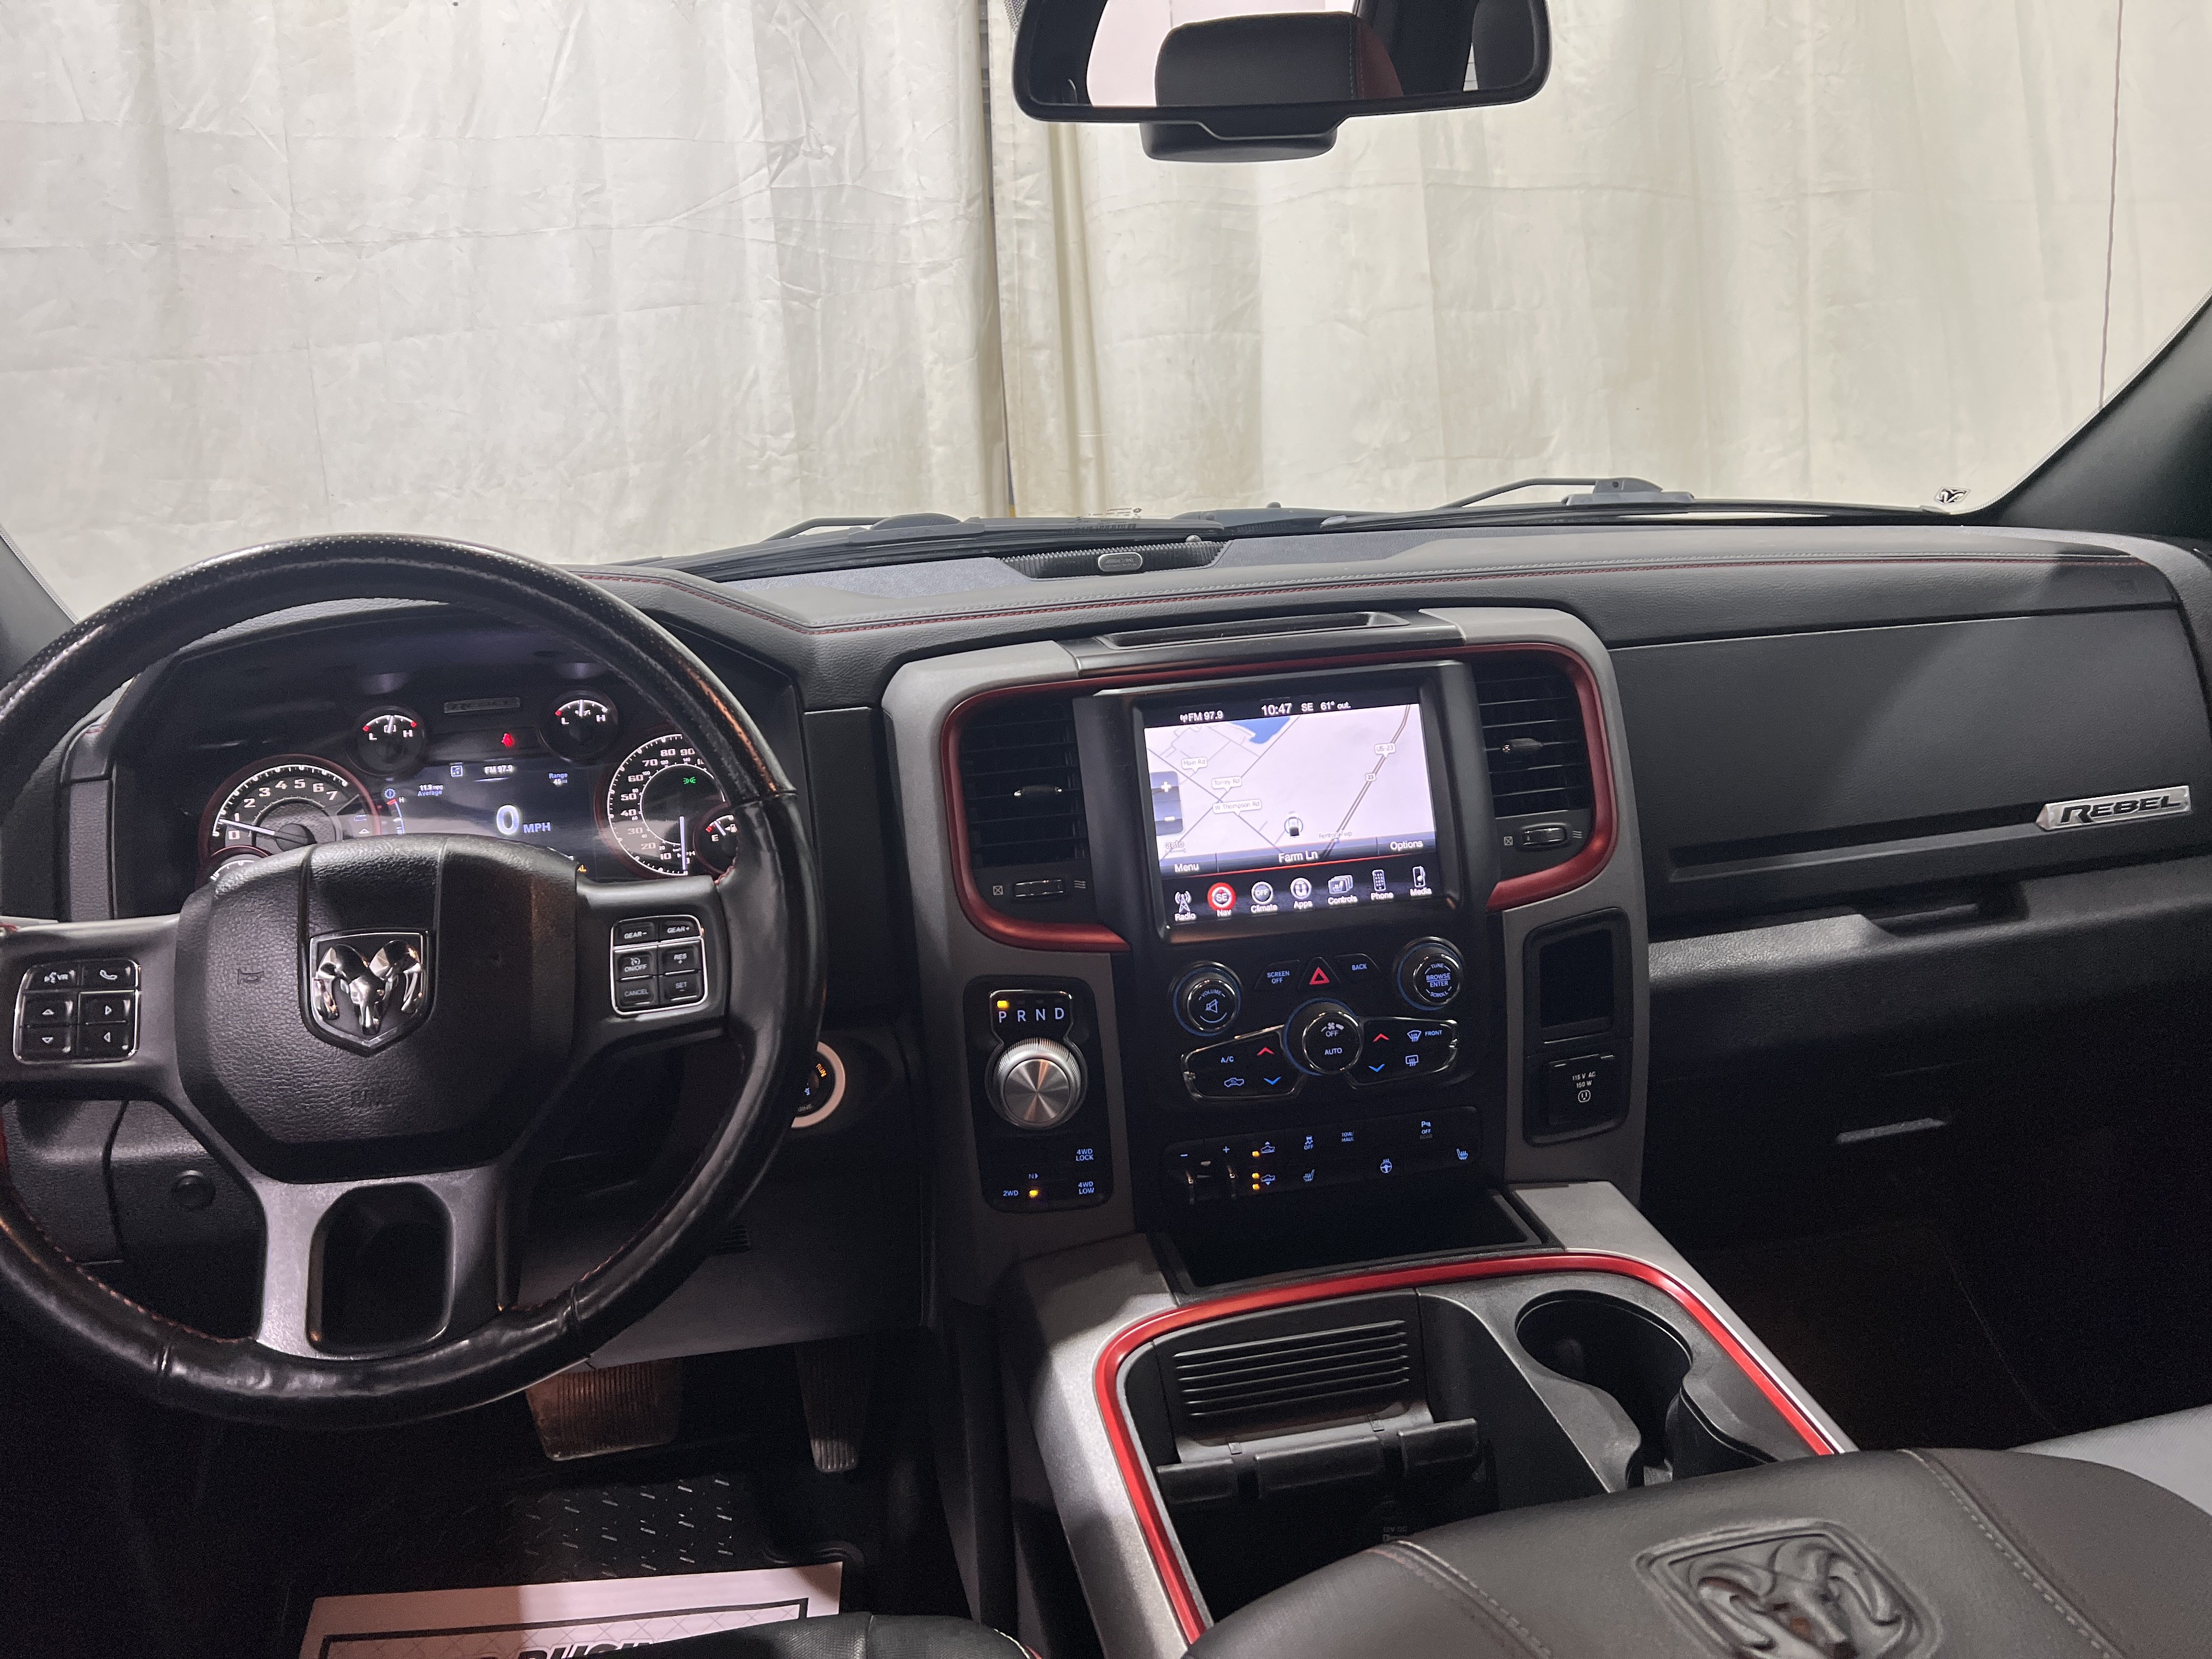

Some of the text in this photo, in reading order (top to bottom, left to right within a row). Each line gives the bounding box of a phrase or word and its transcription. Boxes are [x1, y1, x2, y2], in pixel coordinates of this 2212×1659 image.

[1261, 703, 1292, 716] 10:47
[1301, 703, 1314, 712] SE
[1320, 701, 1351, 711] 61° out.
[1188, 710, 1223, 722] FM 97.9
[369, 732, 377, 741] L
[660, 748, 676, 757] 80
[484, 766, 496, 774] FM
[628, 774, 644, 782] 60
[275, 780, 287, 789] 4
[295, 779, 306, 788] 5
[313, 783, 324, 792] 6
[258, 787, 270, 797] 3
[326, 791, 337, 800] 7
[244, 798, 256, 808] 2
[2060, 795, 2182, 824] REBEL
[234, 812, 240, 821] 1
[496, 804, 551, 835] 0 MPH
[228, 830, 240, 840] 0
[1165, 840, 1184, 849] auto
[1390, 840, 1423, 850] Options
[1278, 850, 1318, 862] Farm Ln
[1175, 863, 1199, 873] Menu
[1370, 891, 1393, 900] Phone
[1410, 887, 1432, 896] Media
[1328, 895, 1358, 905] Controls
[1250, 904, 1278, 913] Climate
[1293, 900, 1313, 910] Apps
[1175, 912, 1197, 921] Radio
[1217, 909, 1232, 917] Nav
[624, 989, 648, 997] CANCEL
[1201, 989, 1222, 998] VOLUME
[998, 1007, 1064, 1023] P R N D
[816, 1063, 827, 1077] RUN
